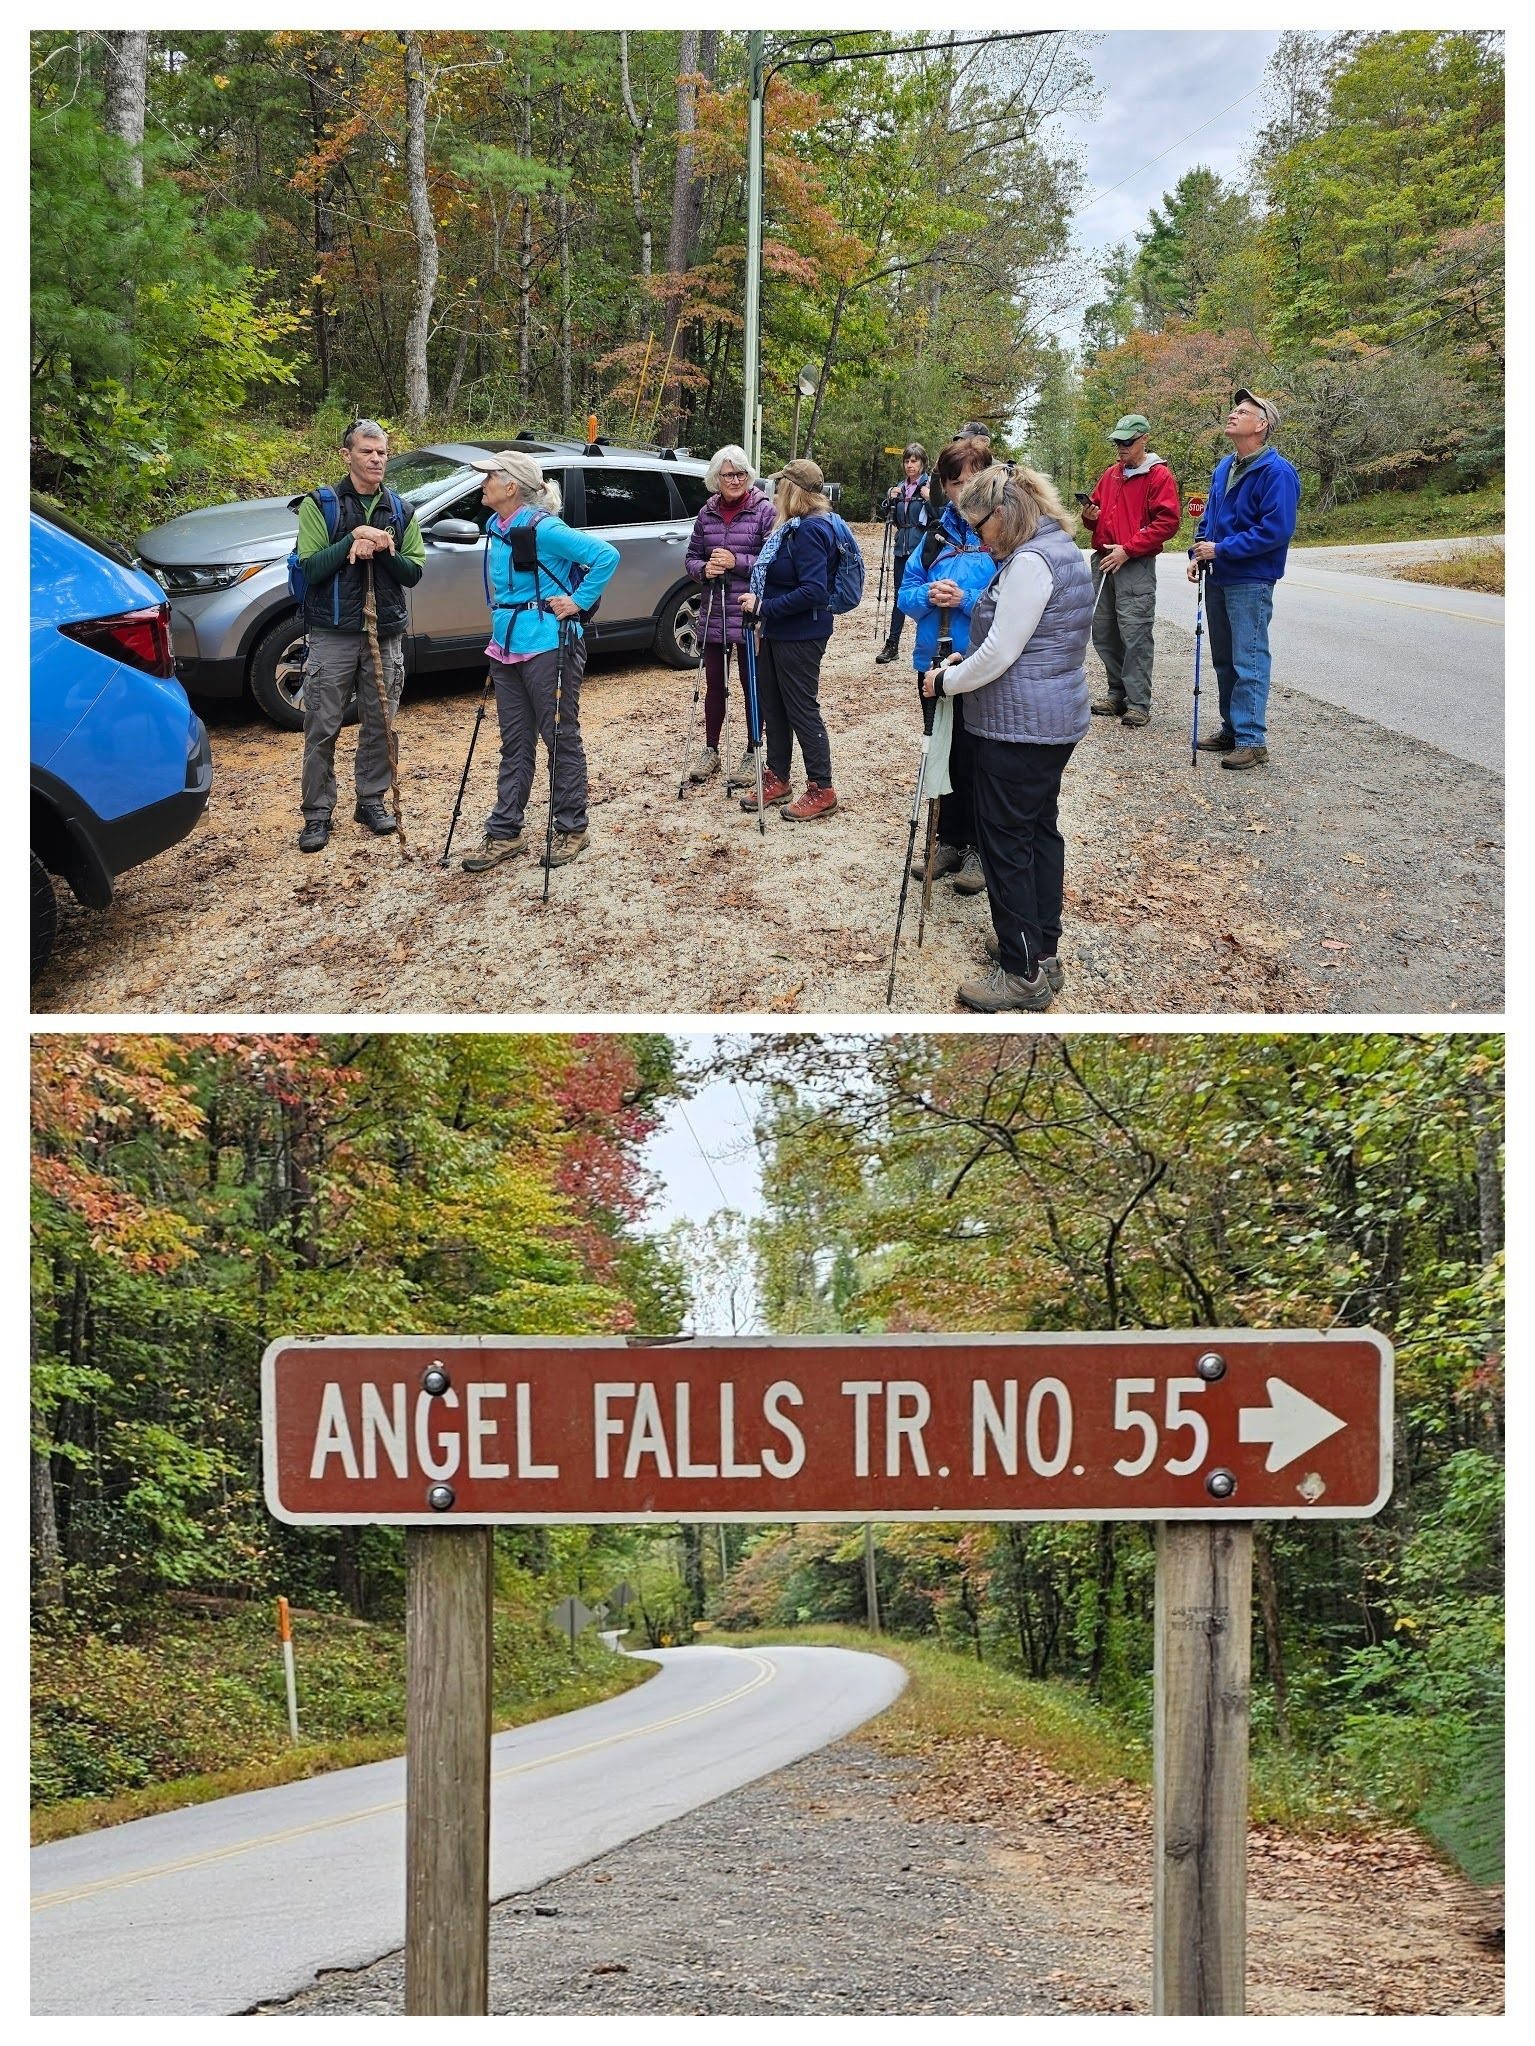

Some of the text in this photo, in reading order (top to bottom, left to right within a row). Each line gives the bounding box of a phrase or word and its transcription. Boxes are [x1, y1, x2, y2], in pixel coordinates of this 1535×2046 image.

[1189, 503, 1204, 511] STOP
[310, 1377, 1209, 1479] ANGEL FALLS TR. NO. 55
